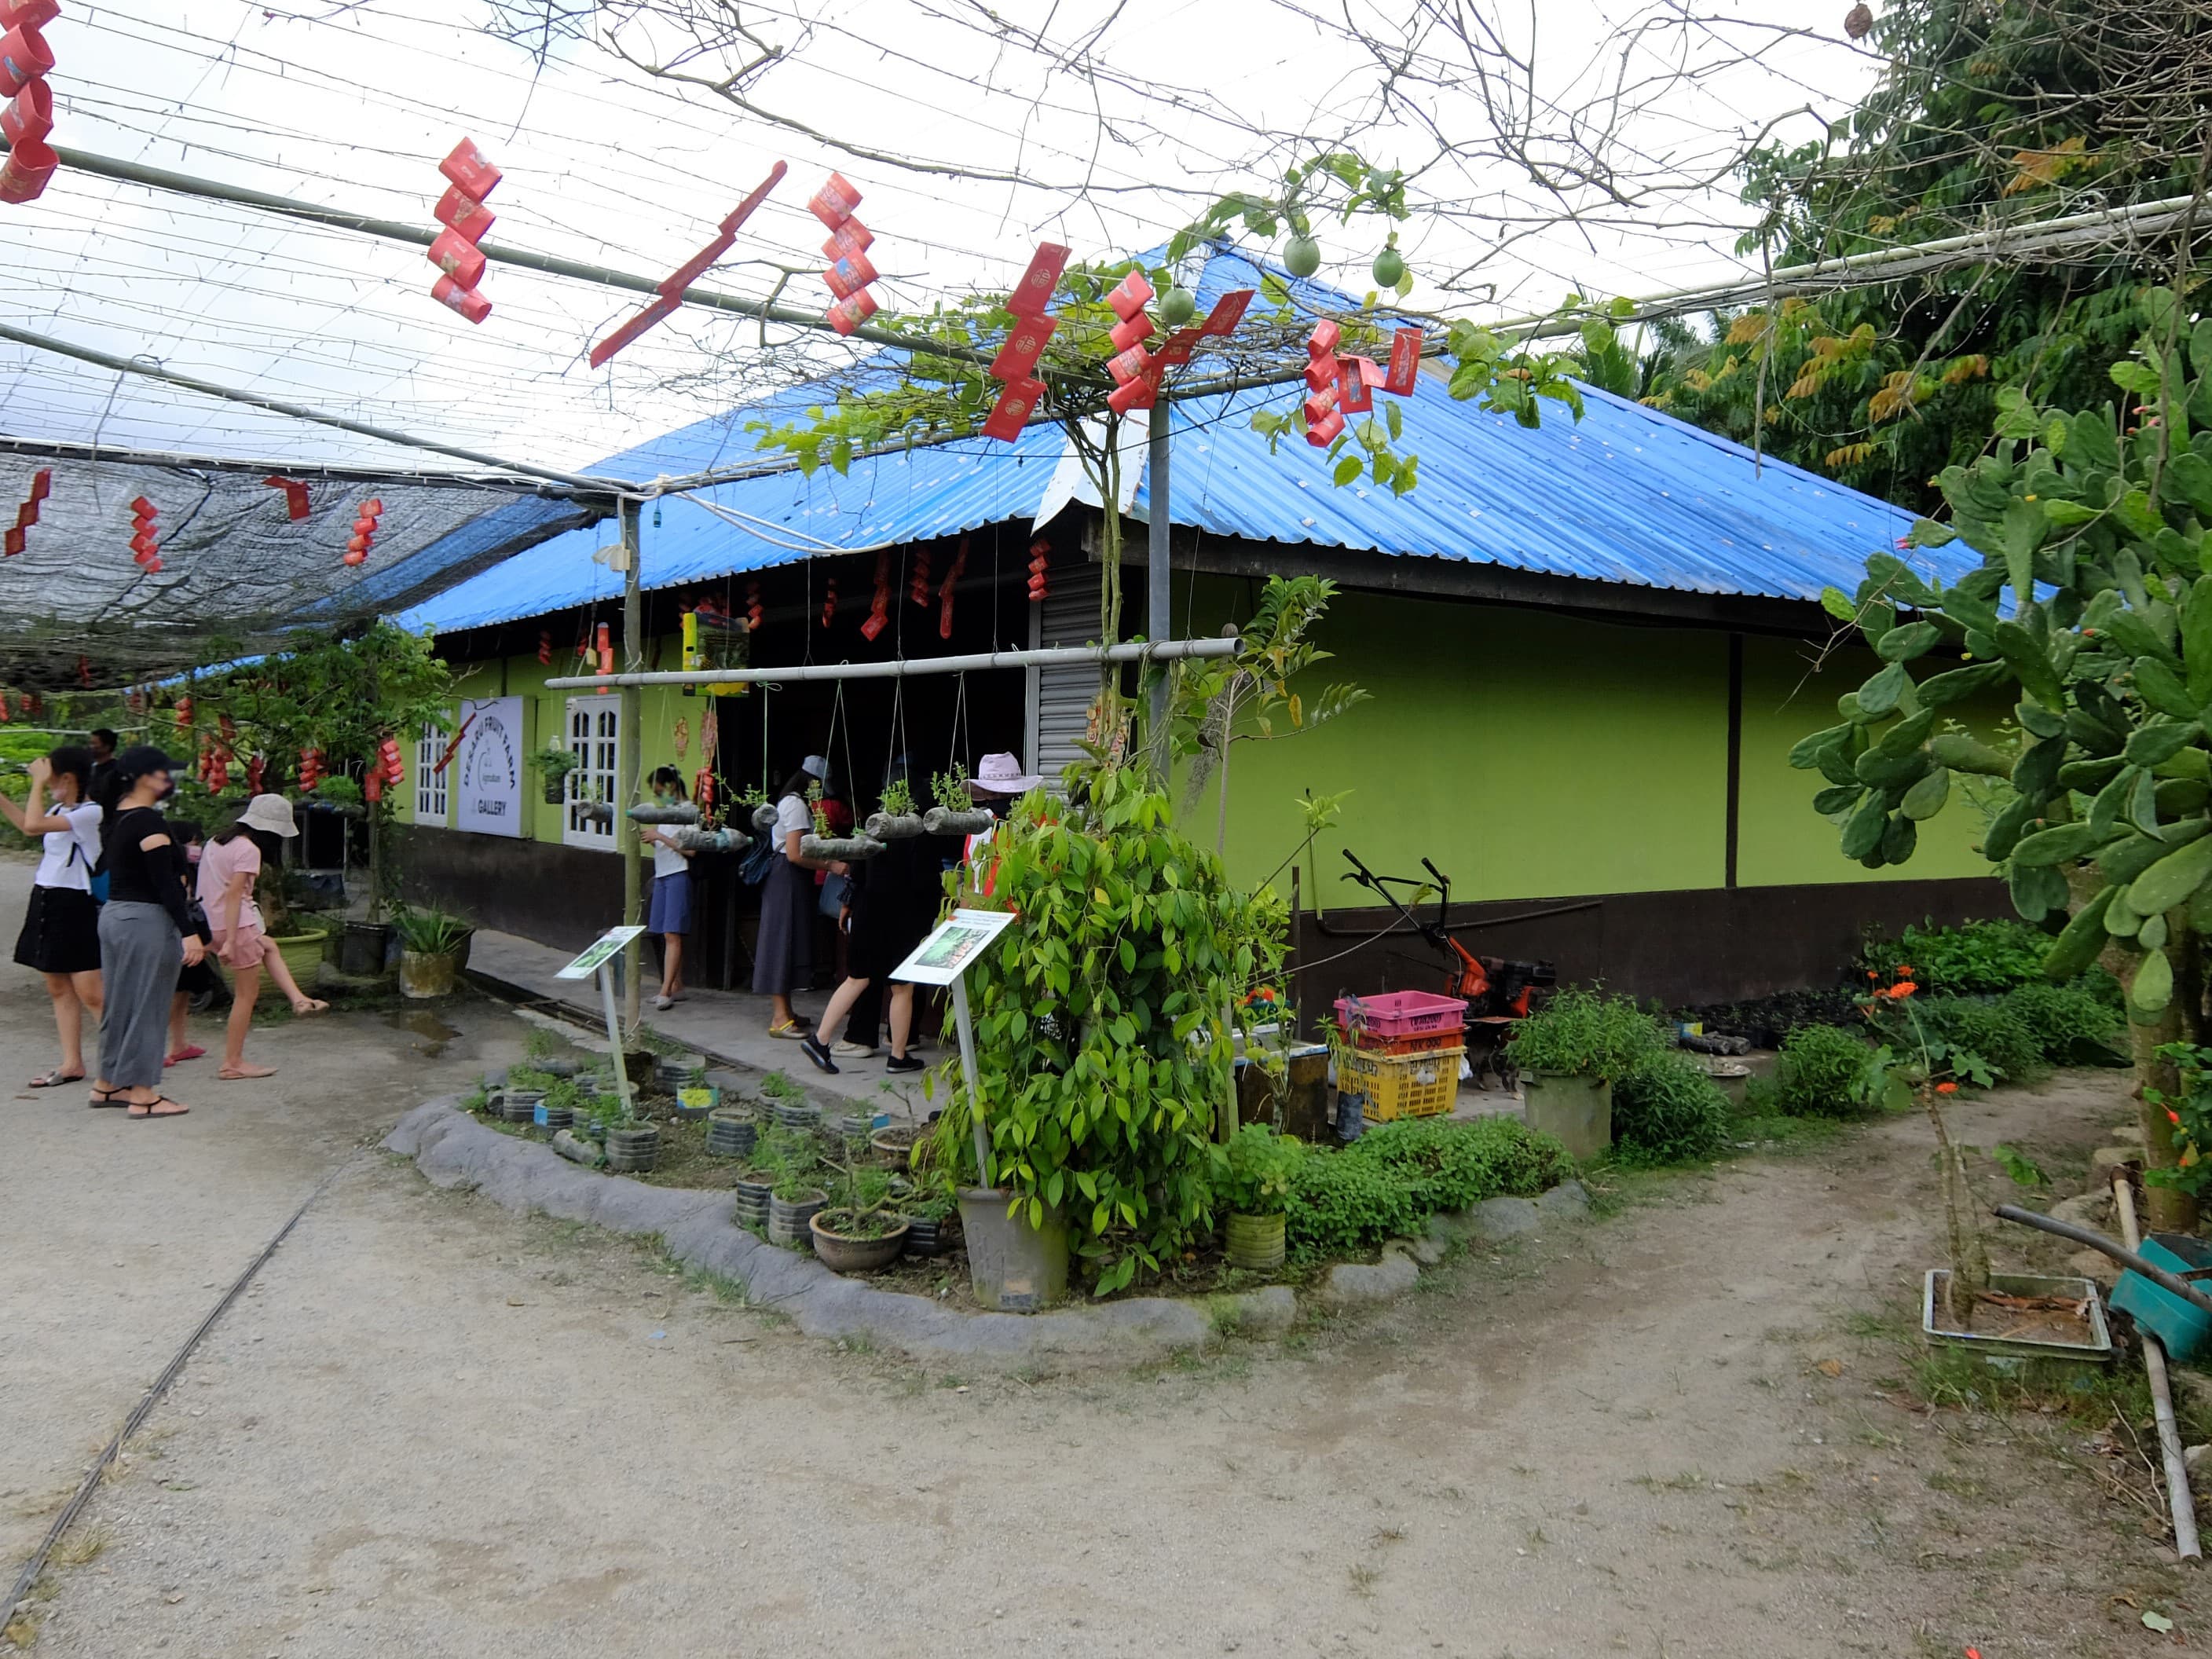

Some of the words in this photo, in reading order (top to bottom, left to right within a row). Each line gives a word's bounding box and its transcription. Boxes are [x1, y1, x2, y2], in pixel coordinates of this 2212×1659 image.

[463, 720, 484, 788] DESARU
[484, 716, 504, 738] FRUIT
[503, 733, 515, 790] FARM
[478, 799, 507, 817] GALLERY
